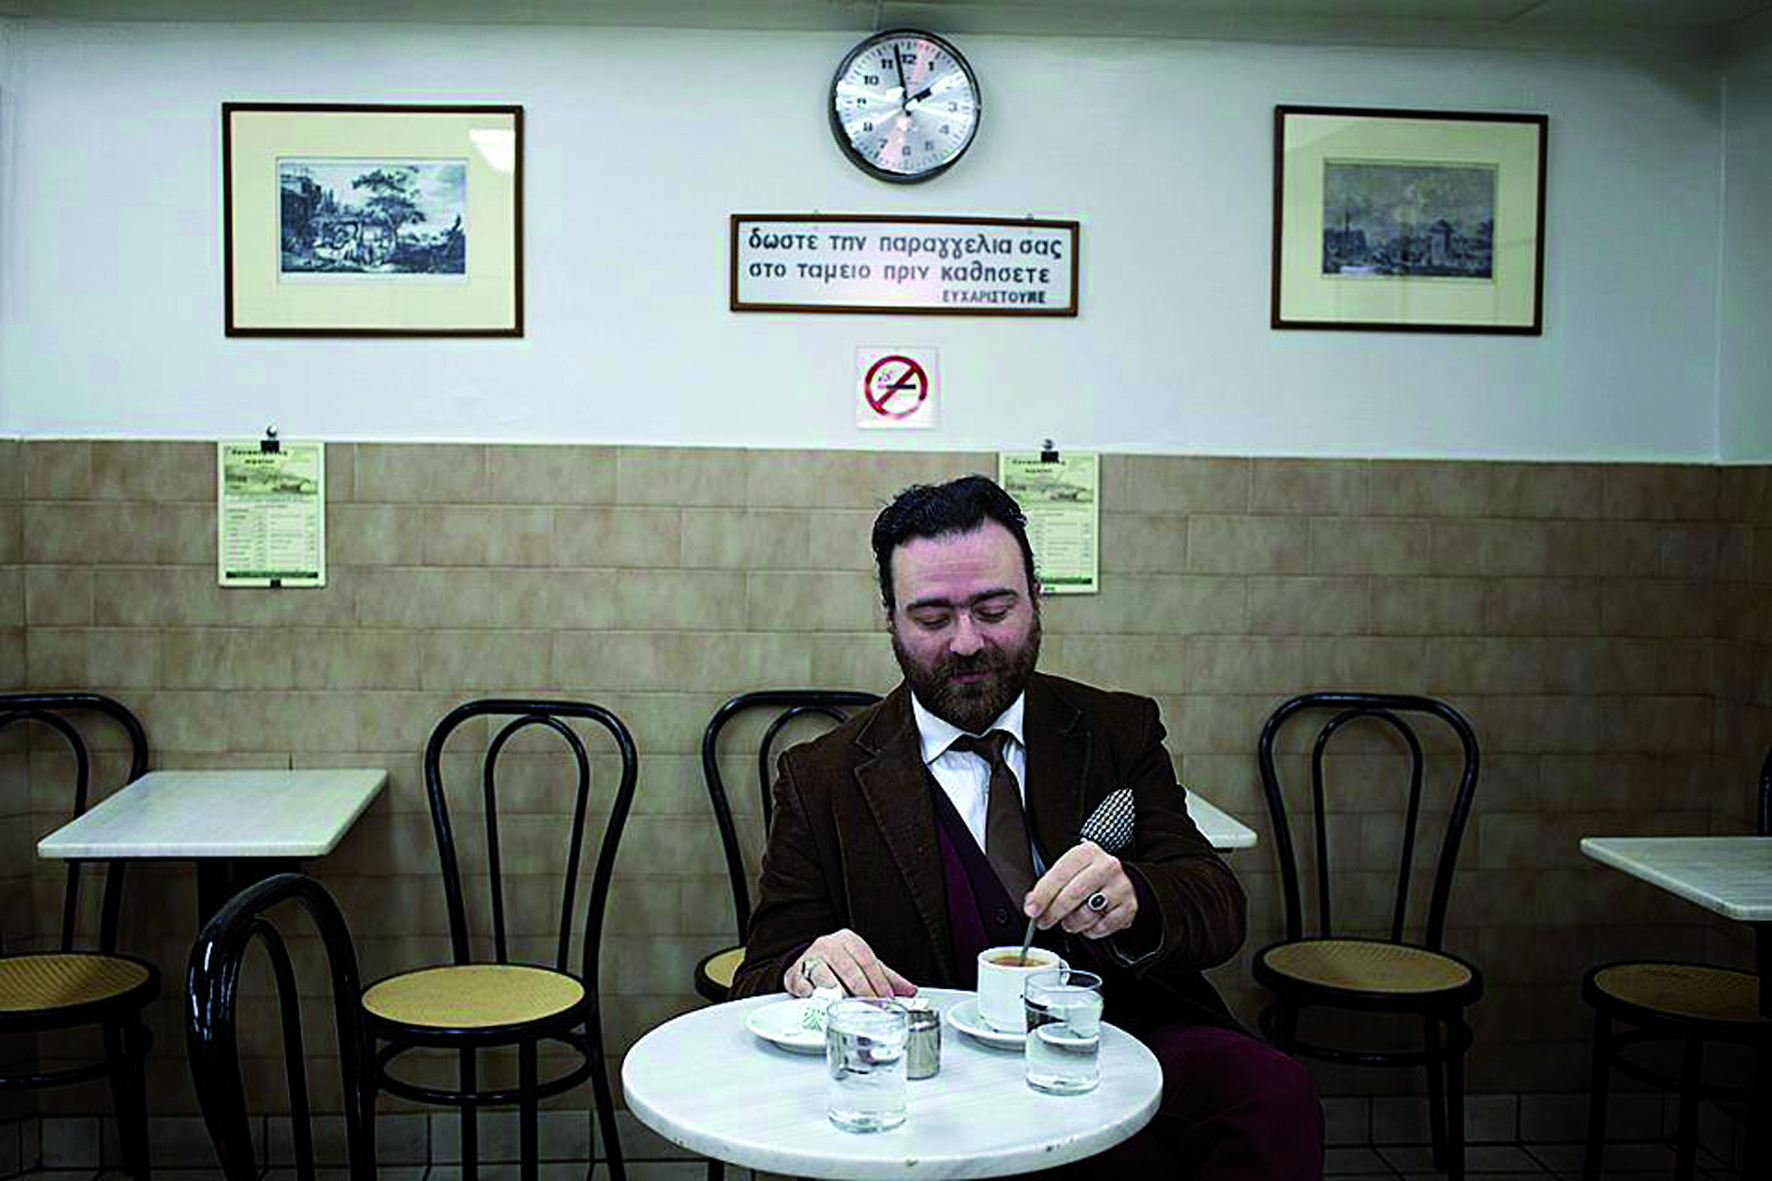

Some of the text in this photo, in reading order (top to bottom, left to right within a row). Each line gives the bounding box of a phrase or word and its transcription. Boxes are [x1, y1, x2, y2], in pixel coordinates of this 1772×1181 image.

[881, 58, 893, 70] 11
[901, 54, 917, 65] 12
[928, 61, 935, 71] 1
[863, 75, 879, 86] 10
[947, 102, 958, 112] 3
[939, 124, 950, 135] 4
[878, 138, 888, 149] 7
[749, 227, 1062, 259] δωστε την παραγγελια σας
[749, 260, 1050, 285] στο ταμειο πριν καθησετε
[943, 290, 1046, 304] ΕΥΧΑΡΙΣΤΟΥΜΕ
